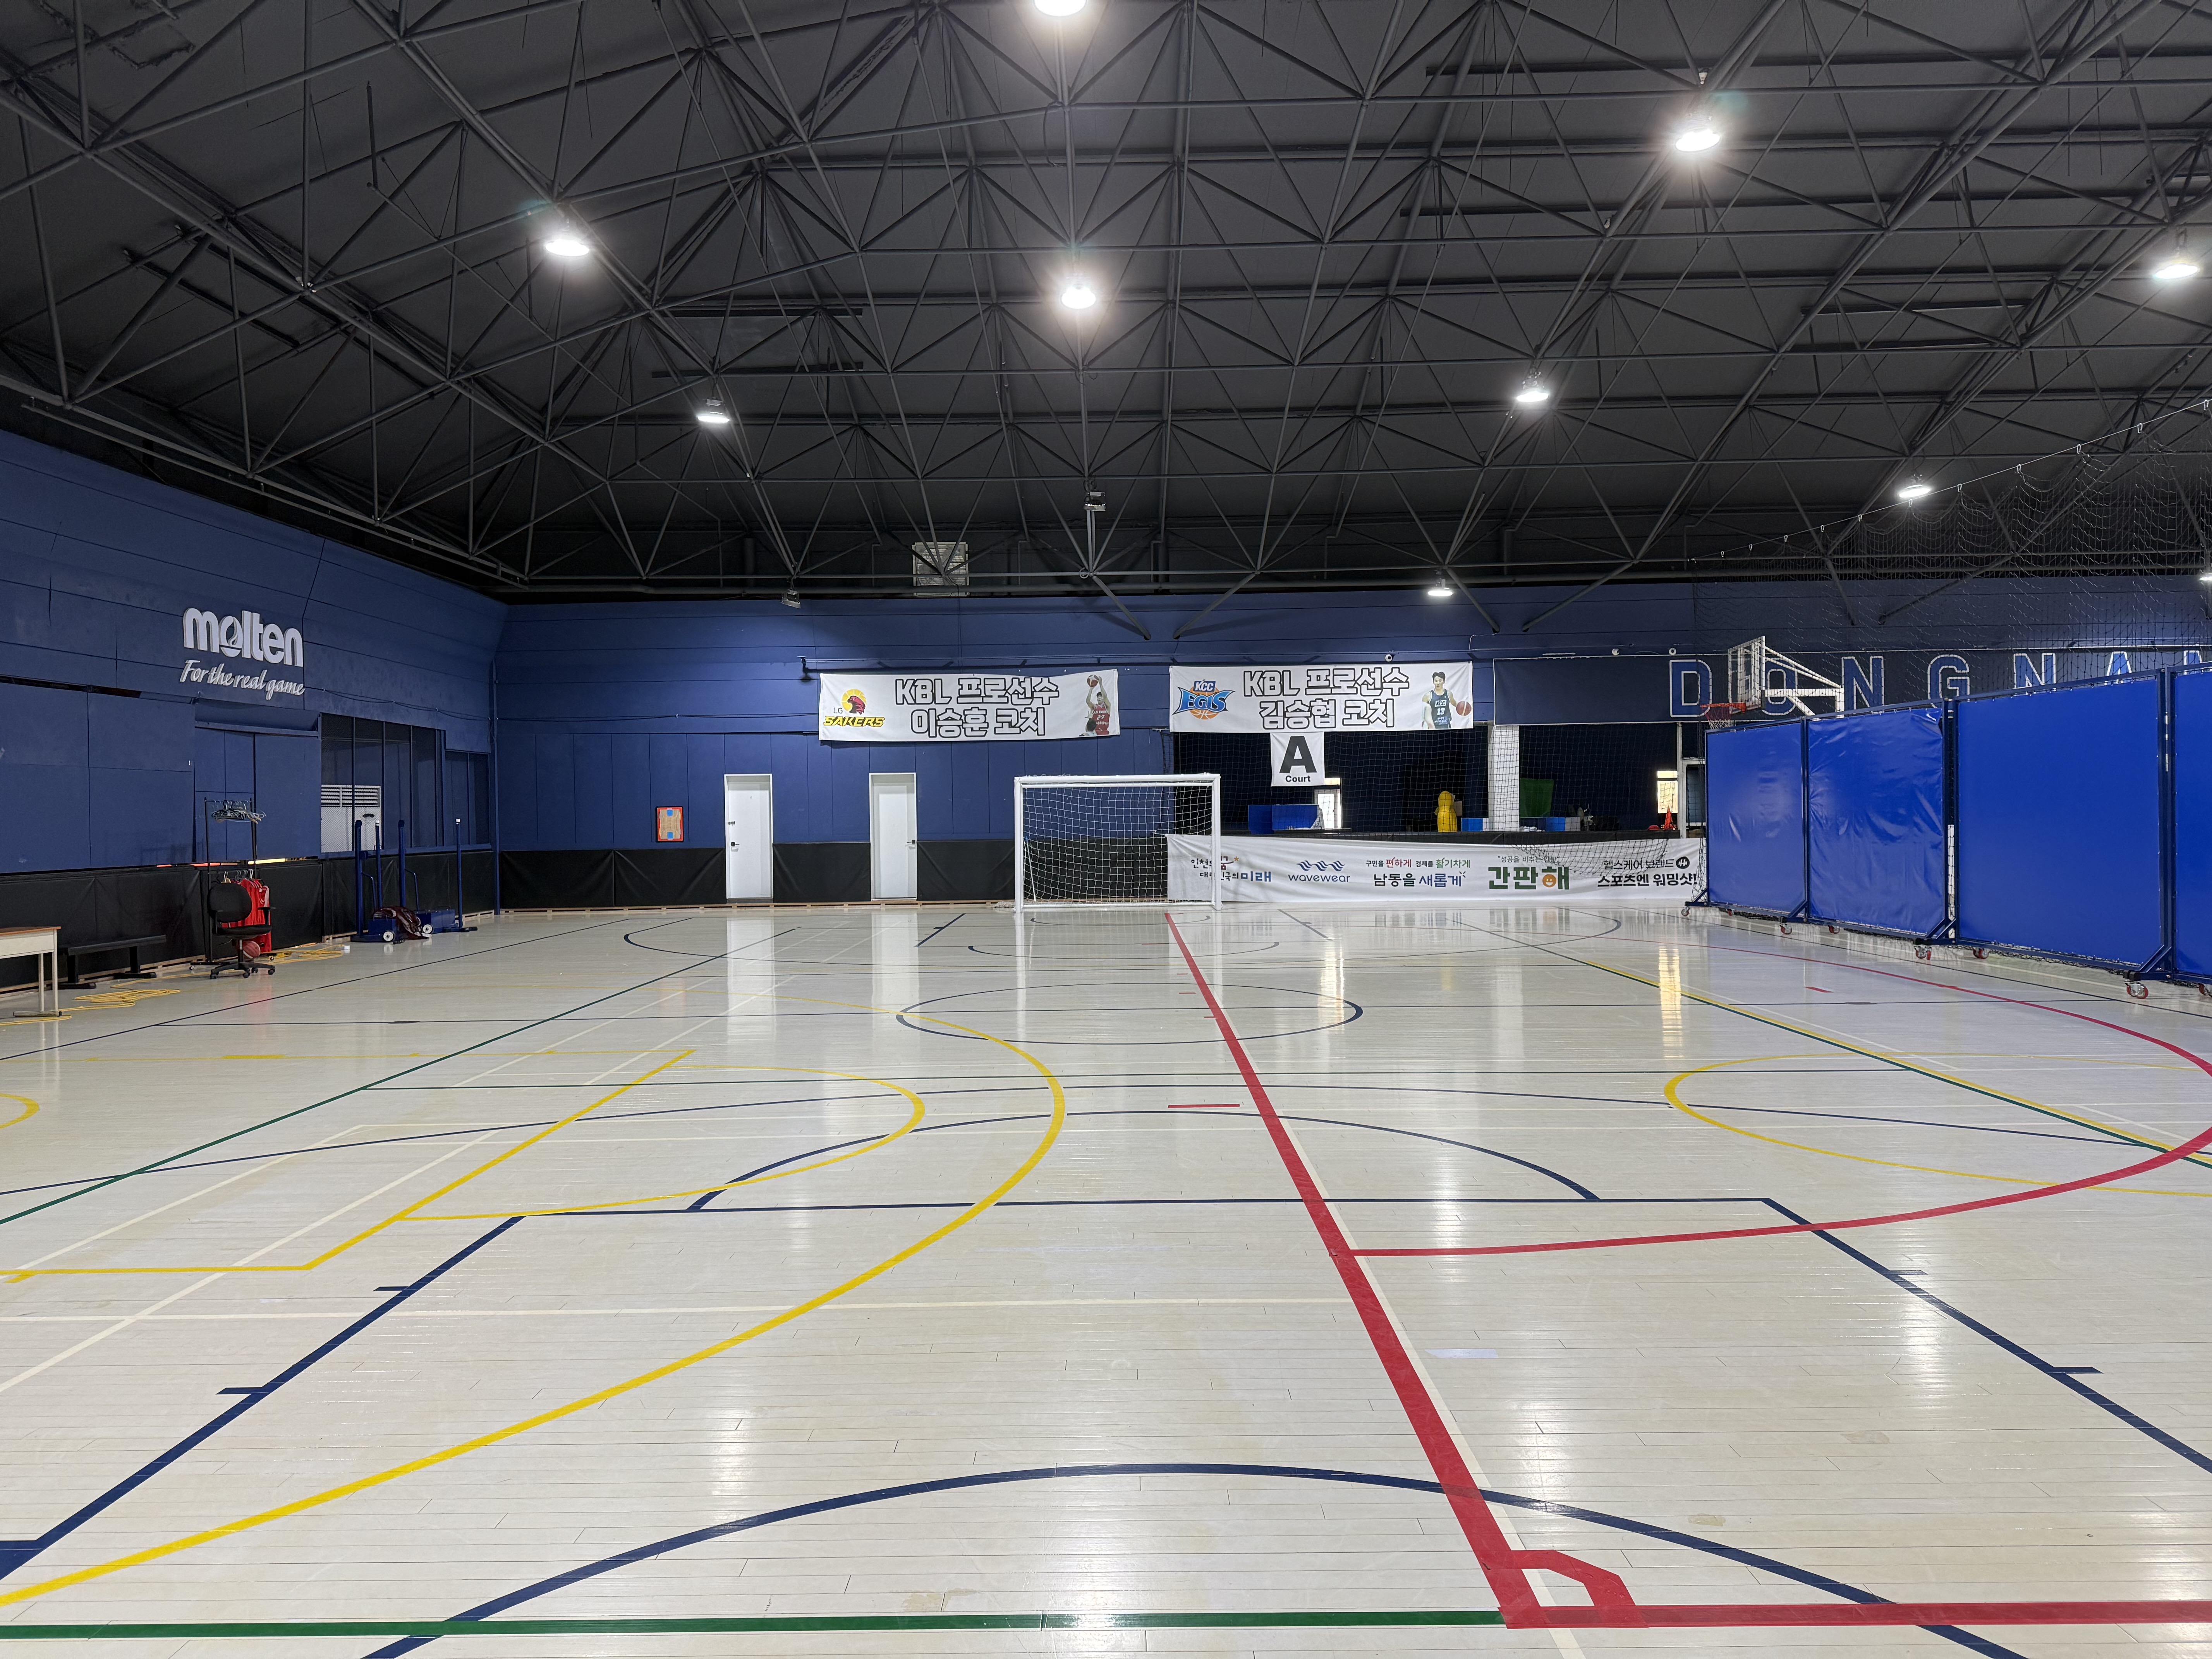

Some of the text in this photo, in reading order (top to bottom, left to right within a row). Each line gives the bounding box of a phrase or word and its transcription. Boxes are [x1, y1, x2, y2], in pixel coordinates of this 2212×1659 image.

[183, 608, 303, 667] molten
[179, 660, 305, 700] For the real game
[895, 677, 1060, 706] KBL 프로선수
[1195, 680, 1214, 691] KCC
[1243, 667, 1410, 697] KBL 프로선수
[1171, 687, 1235, 715] EGIS
[1259, 698, 1395, 730] 김승협 코치
[823, 716, 885, 727] SAKERS
[911, 707, 1046, 738] 이승훈 코치
[1279, 736, 1317, 773] A
[1386, 857, 1412, 867] 편하게
[1436, 858, 1470, 868] 활기차게
[1604, 859, 1674, 869] 헬스케어 브랜드
[1241, 871, 1271, 882] 미래
[1374, 873, 1462, 887] 남동을 새롭게
[1488, 866, 1569, 890] 간판해
[1598, 874, 1649, 887] 스포츠엔
